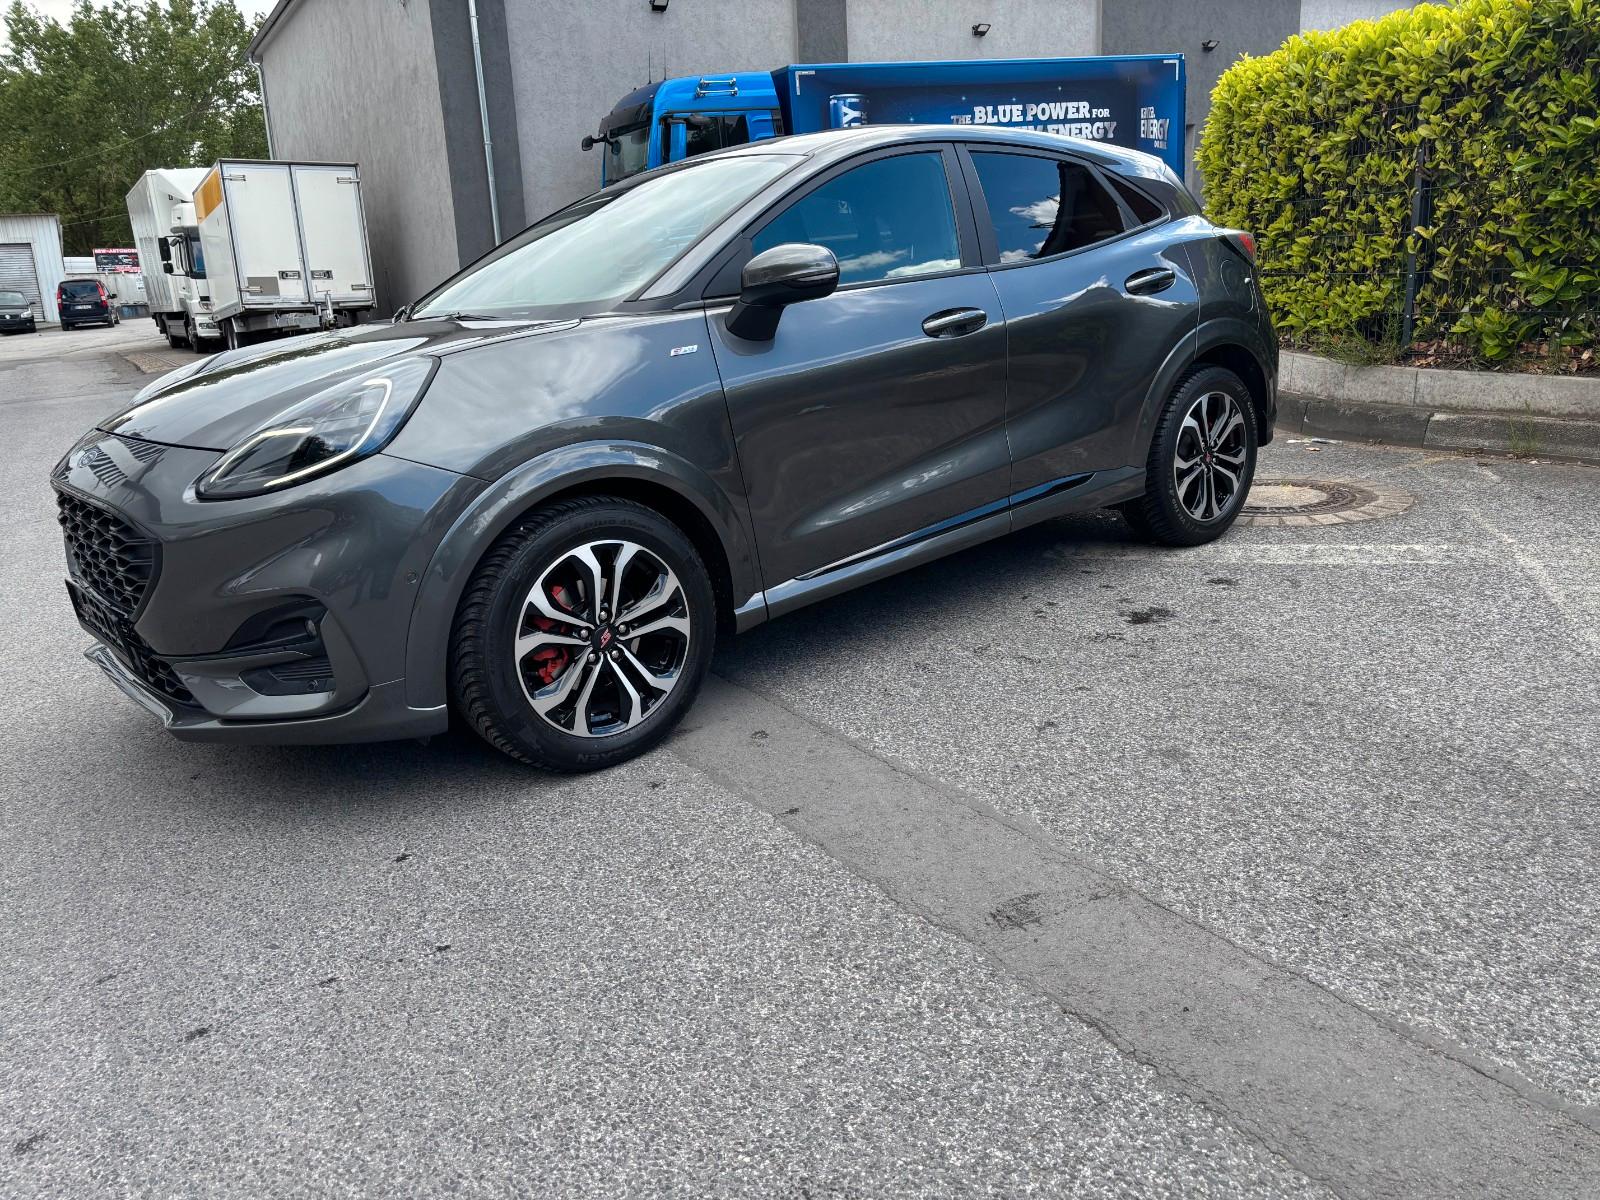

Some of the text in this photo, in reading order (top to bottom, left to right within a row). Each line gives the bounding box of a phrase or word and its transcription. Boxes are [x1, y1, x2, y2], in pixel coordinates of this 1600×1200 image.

[951, 101, 1111, 125] THE BLUE POWER FOR
[1047, 121, 1117, 139] ENERGY
[1141, 118, 1169, 141] ENERGY
